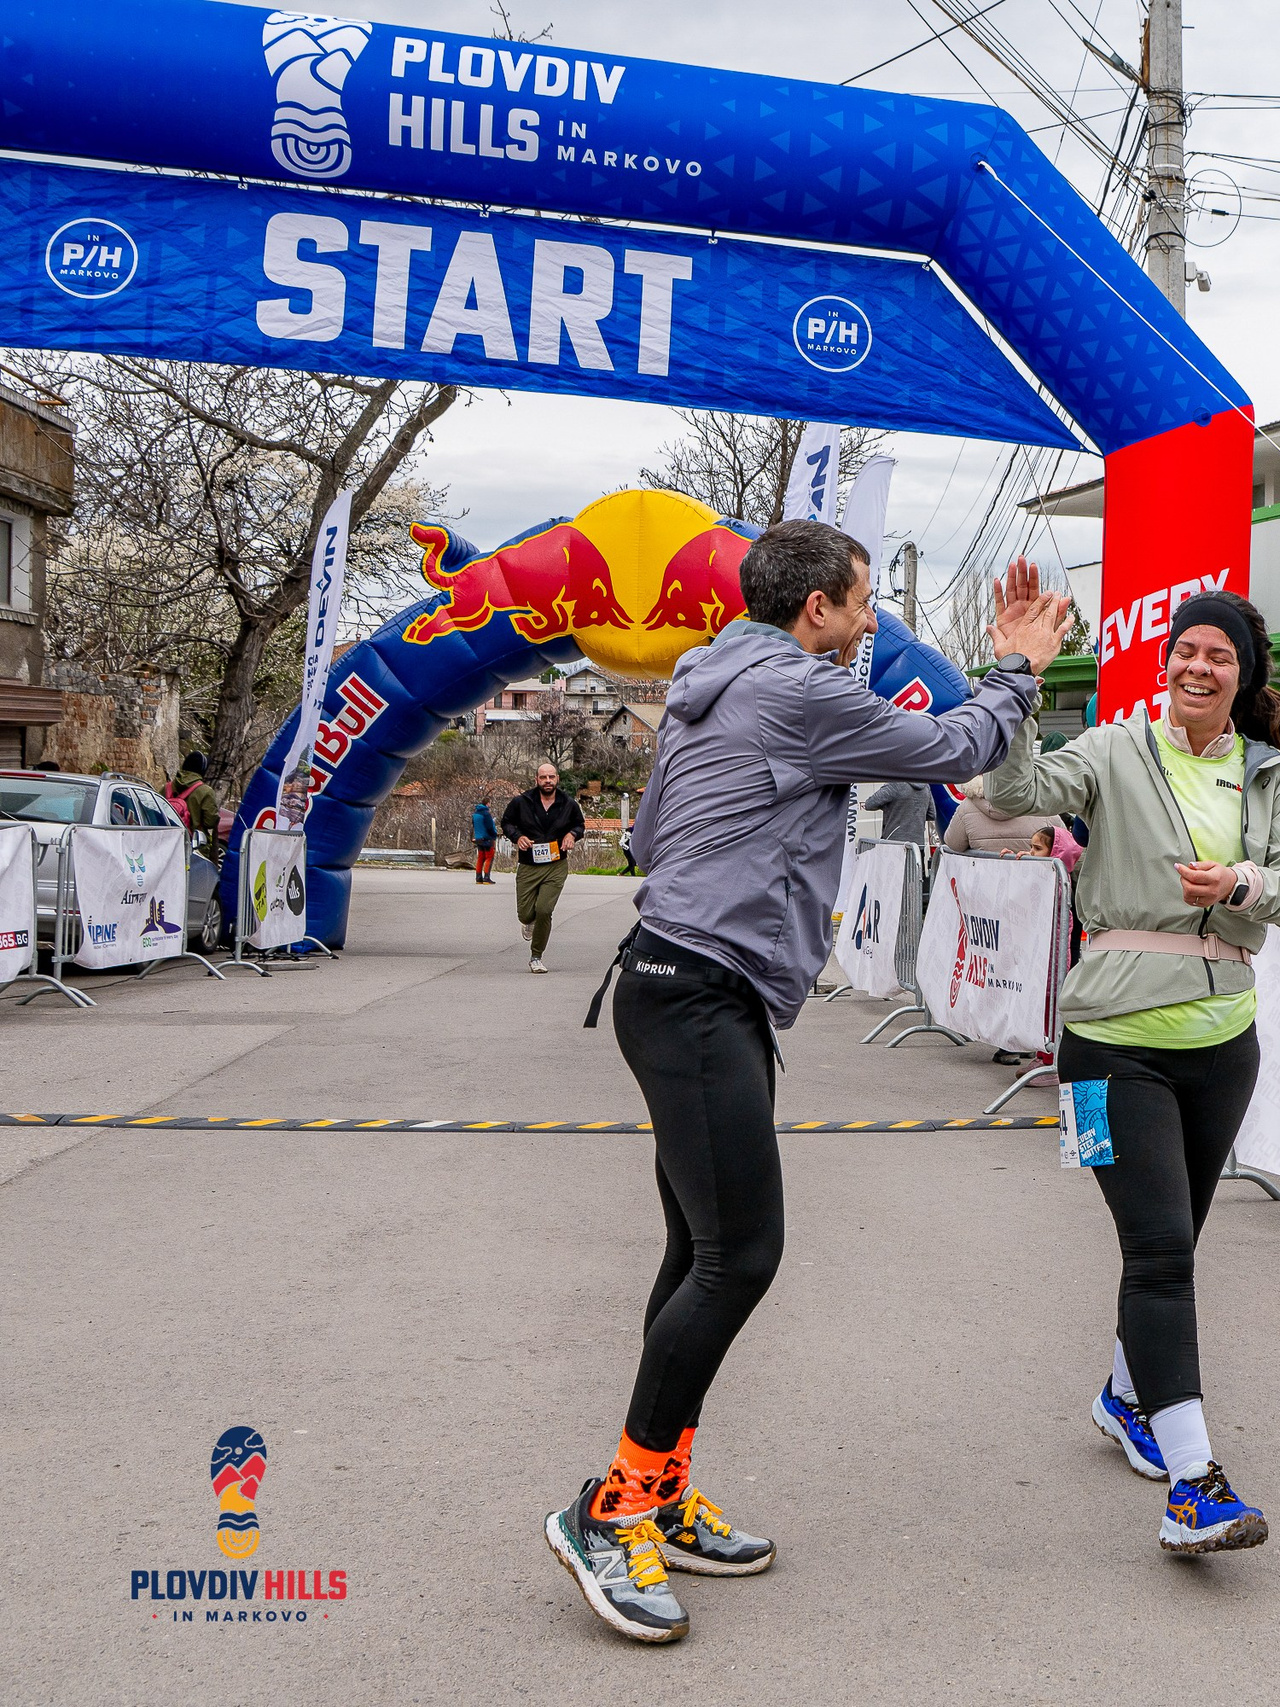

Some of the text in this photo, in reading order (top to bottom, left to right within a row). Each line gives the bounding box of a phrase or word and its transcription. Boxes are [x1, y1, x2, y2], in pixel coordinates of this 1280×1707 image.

[391, 36, 626, 104] PLOVDIV
[388, 92, 540, 162] HILLS
[558, 120, 587, 139] IN
[557, 145, 702, 177] MARKOVO
[87, 234, 100, 242] IN
[62, 242, 122, 268] P/H
[60, 269, 119, 279] MARKOVO
[256, 212, 693, 377] START
[828, 310, 839, 318] IN
[807, 317, 858, 345] P/H
[807, 343, 857, 355] MARKOVO
[314, 674, 387, 766] Bull
[636, 960, 676, 976] KIPRUN
